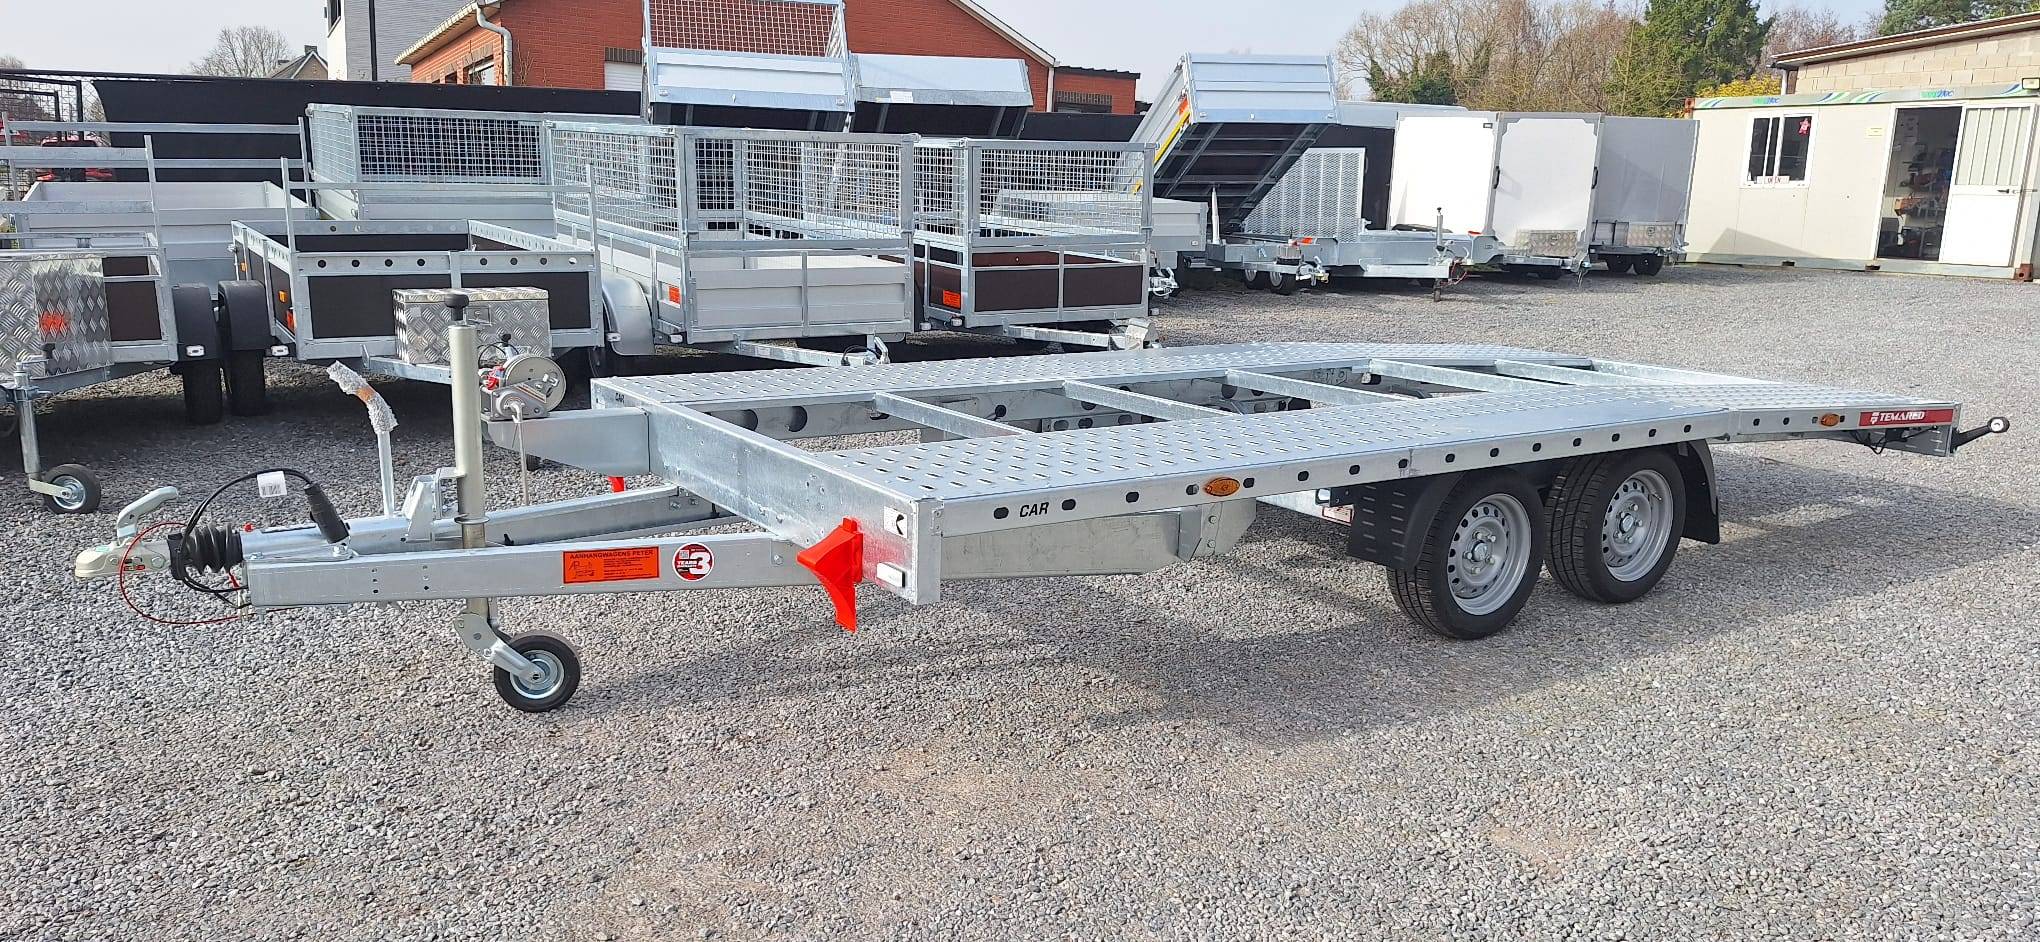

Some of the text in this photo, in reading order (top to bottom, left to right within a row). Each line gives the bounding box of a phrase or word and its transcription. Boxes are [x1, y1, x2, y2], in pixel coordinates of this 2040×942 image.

[1879, 411, 1925, 422] TEMARED
[1019, 501, 1050, 518] CAR
[569, 551, 631, 559] AANHANGWAGENS
[688, 551, 711, 575] 3
